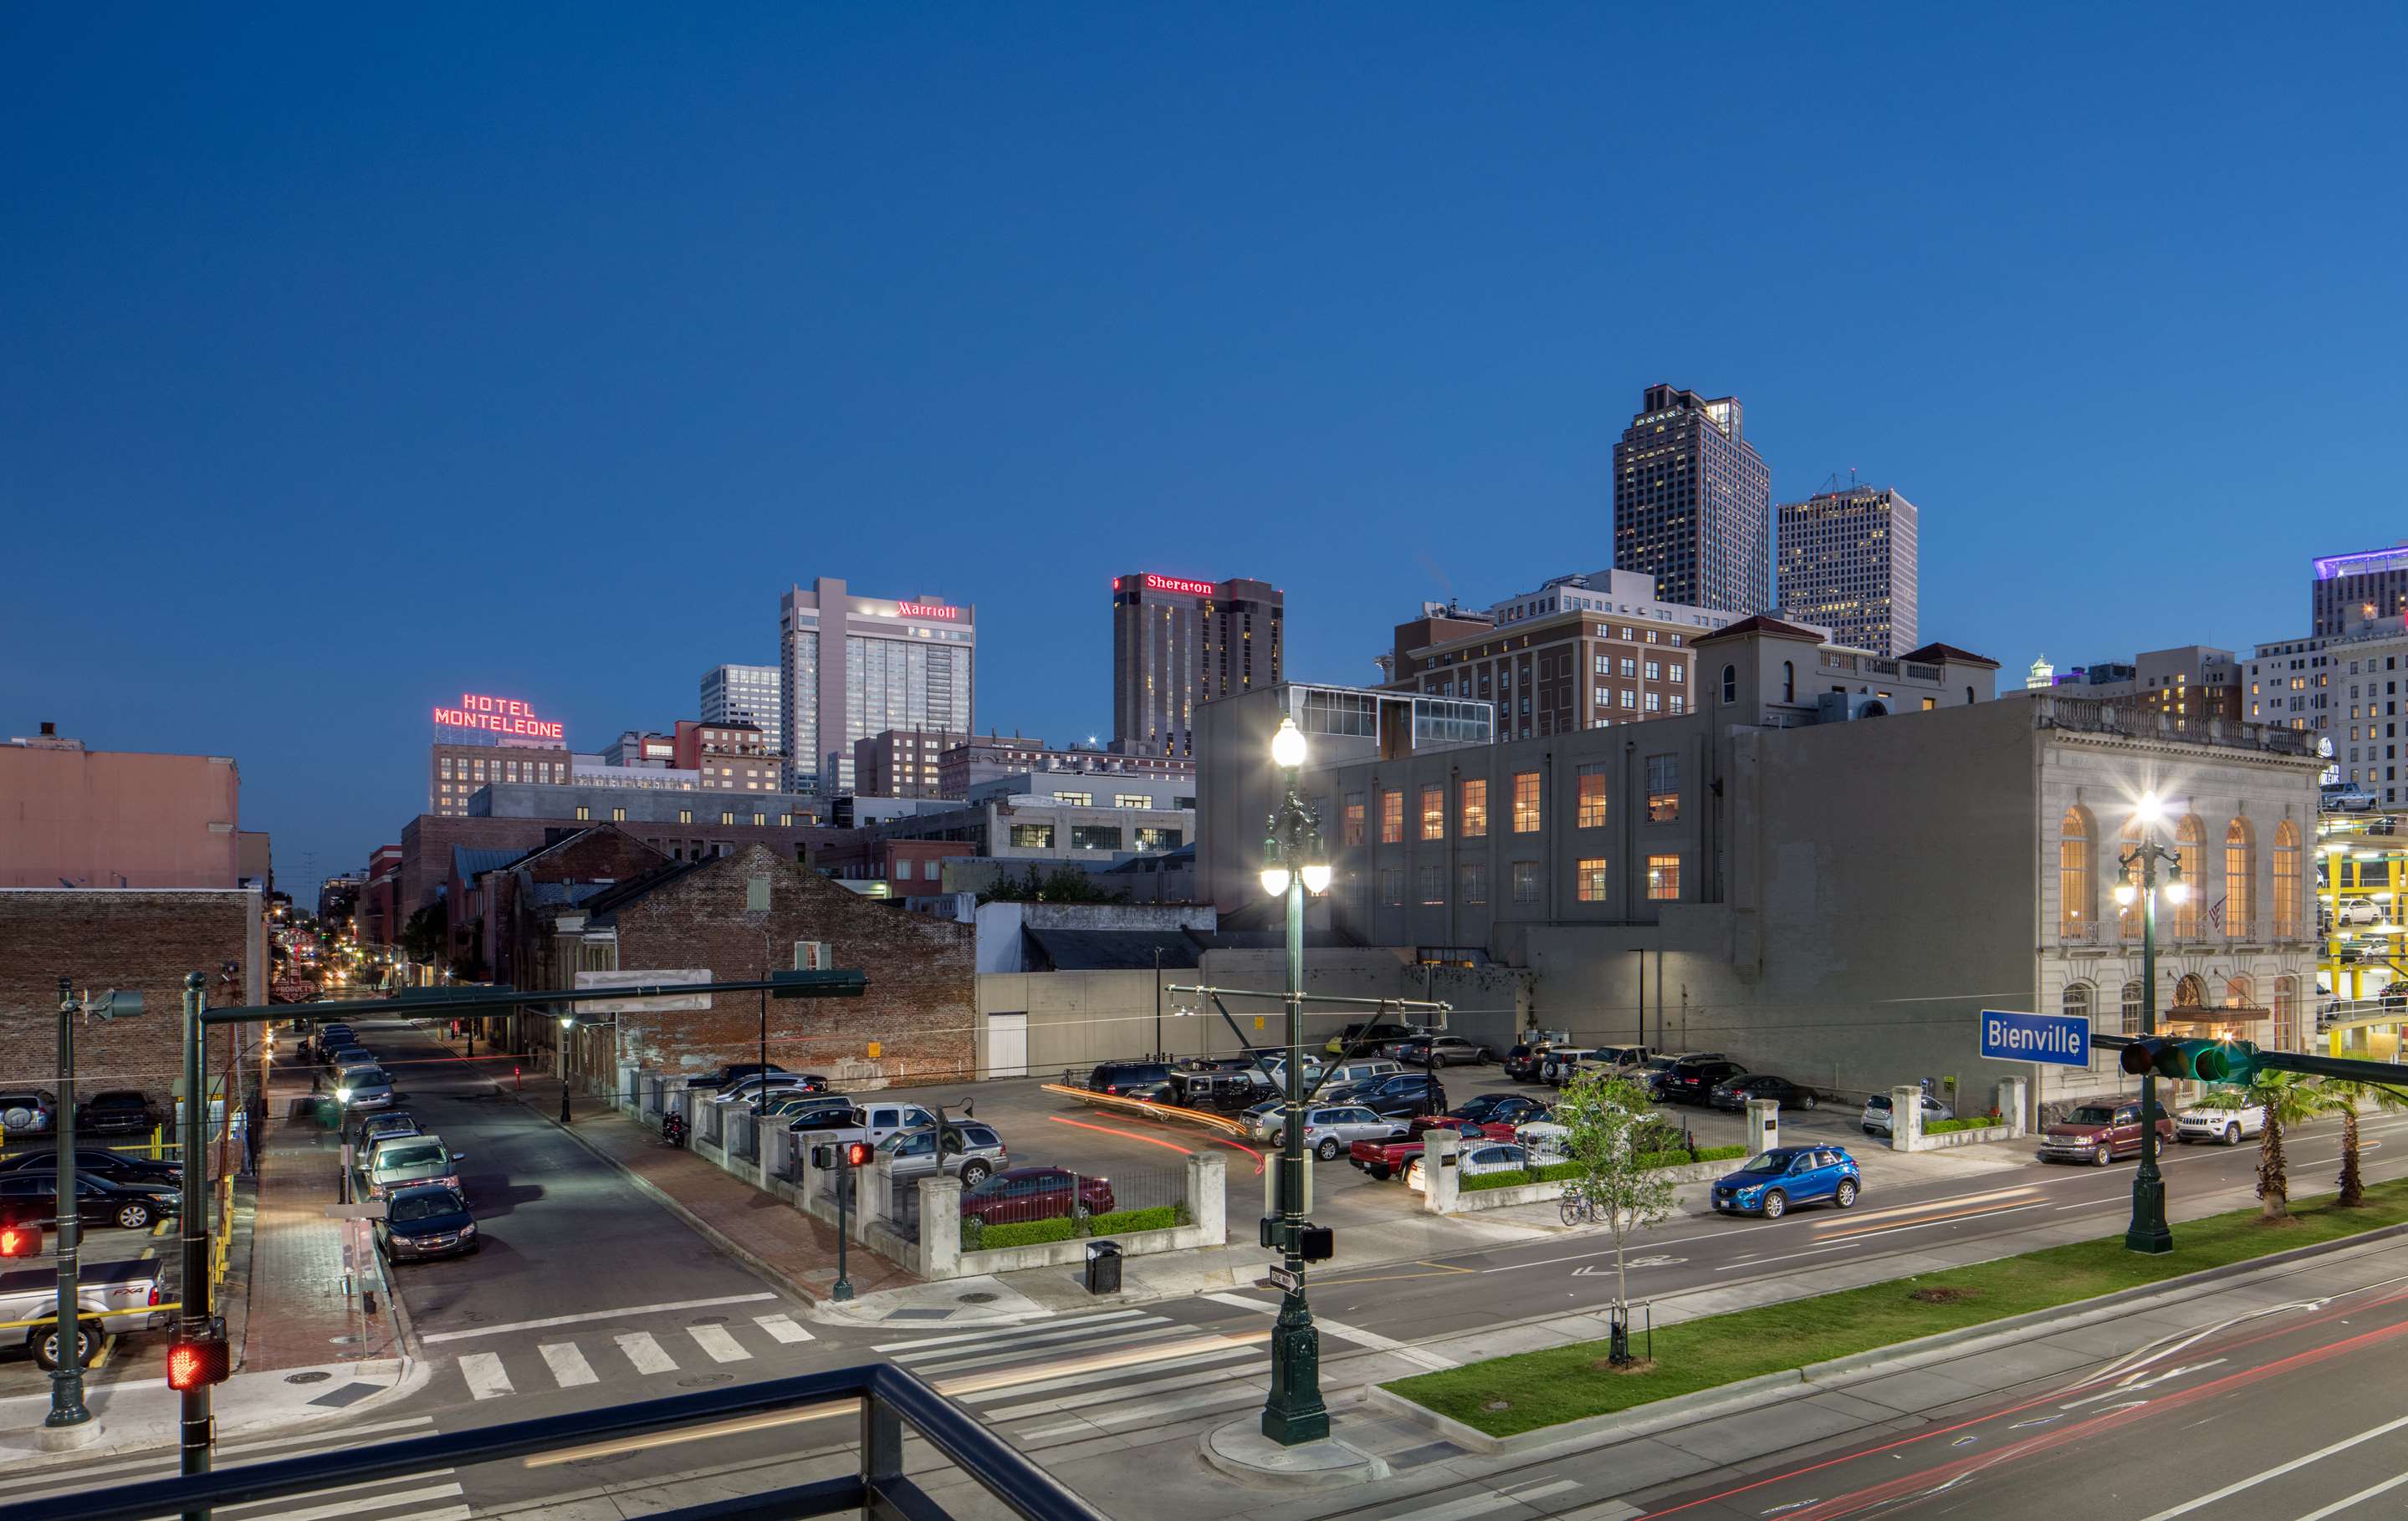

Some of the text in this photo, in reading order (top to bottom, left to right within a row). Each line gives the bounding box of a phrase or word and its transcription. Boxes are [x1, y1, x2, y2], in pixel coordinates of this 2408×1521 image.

[1148, 575, 1212, 594] Sheraton
[896, 601, 955, 618] Marriott
[463, 694, 535, 717] HOTEL
[434, 708, 563, 738] MONTELEONE
[1988, 1020, 2081, 1054] Bienville
[1272, 1273, 1281, 1284] ONE
[113, 1288, 144, 1296] FX4
